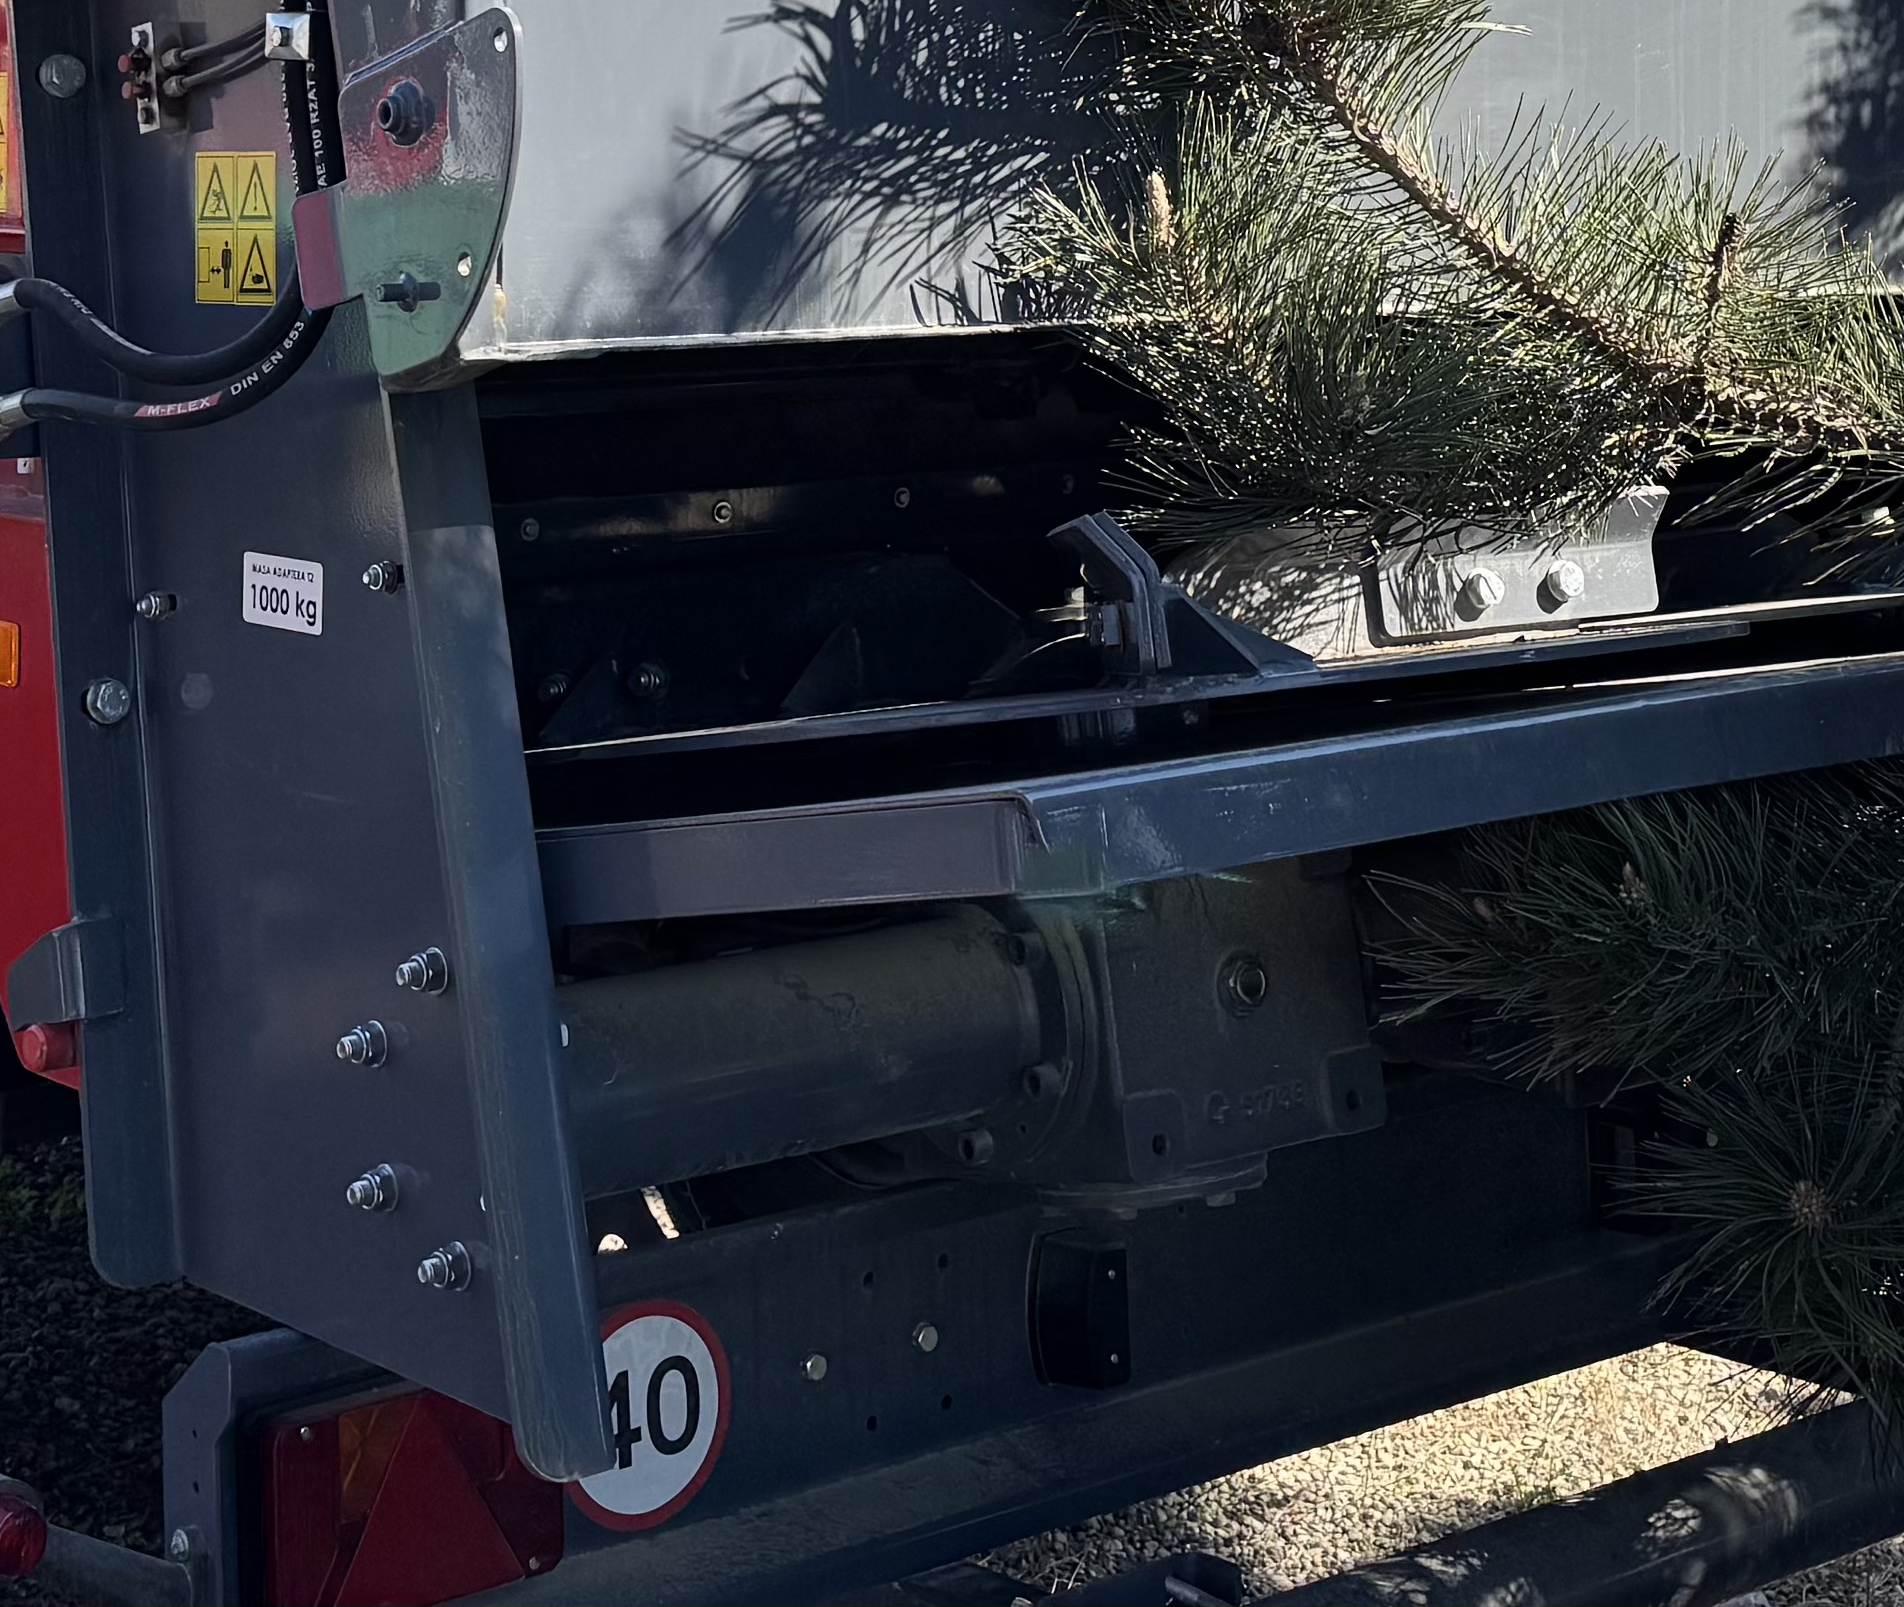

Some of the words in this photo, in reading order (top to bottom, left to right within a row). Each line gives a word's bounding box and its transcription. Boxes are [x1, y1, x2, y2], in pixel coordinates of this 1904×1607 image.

[312, 129, 325, 157] 100
[315, 162, 328, 190] AE
[147, 396, 211, 417] M-FLEX
[230, 372, 259, 396] DIN
[261, 351, 284, 374] EN
[283, 321, 304, 350] 853
[251, 583, 290, 616] 1000
[295, 591, 317, 627] kg
[608, 1355, 700, 1470] 40
